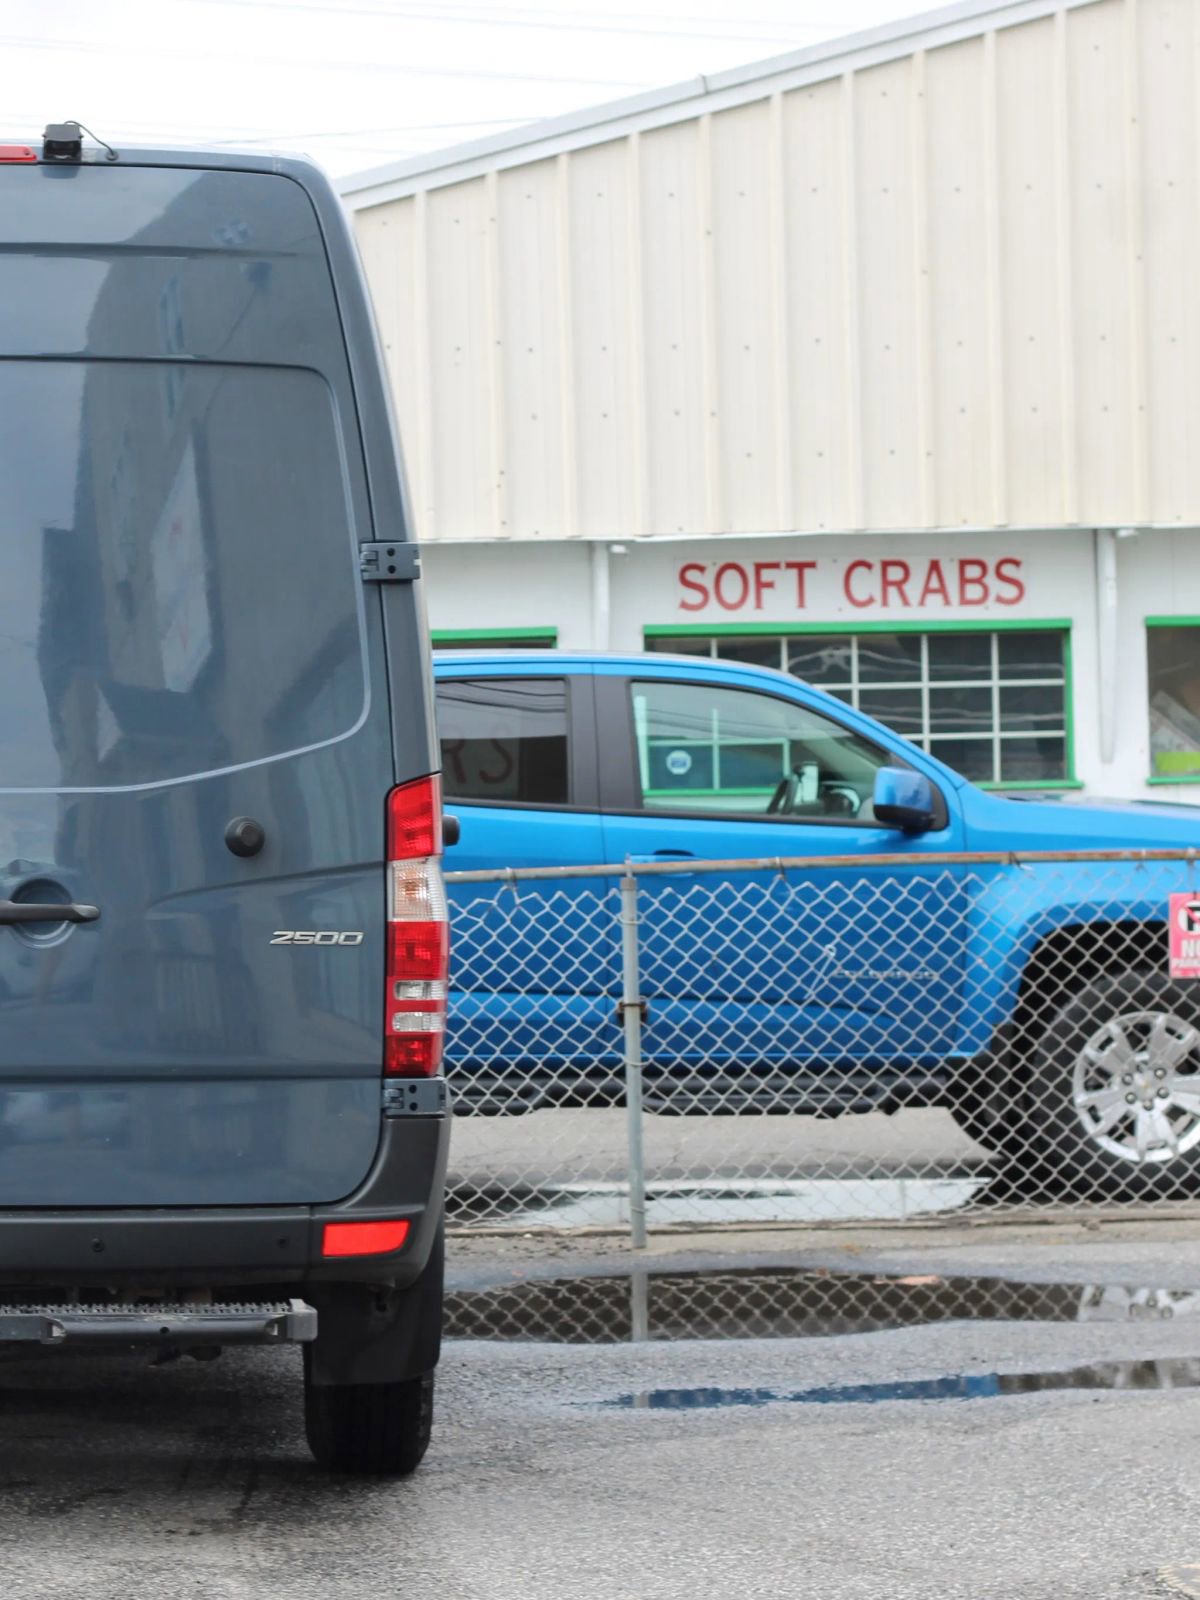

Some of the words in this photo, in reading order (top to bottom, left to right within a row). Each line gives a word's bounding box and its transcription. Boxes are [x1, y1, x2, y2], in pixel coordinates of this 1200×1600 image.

[678, 559, 818, 612] SOFT
[843, 557, 1026, 609] CRABS
[270, 931, 364, 945] 2500
